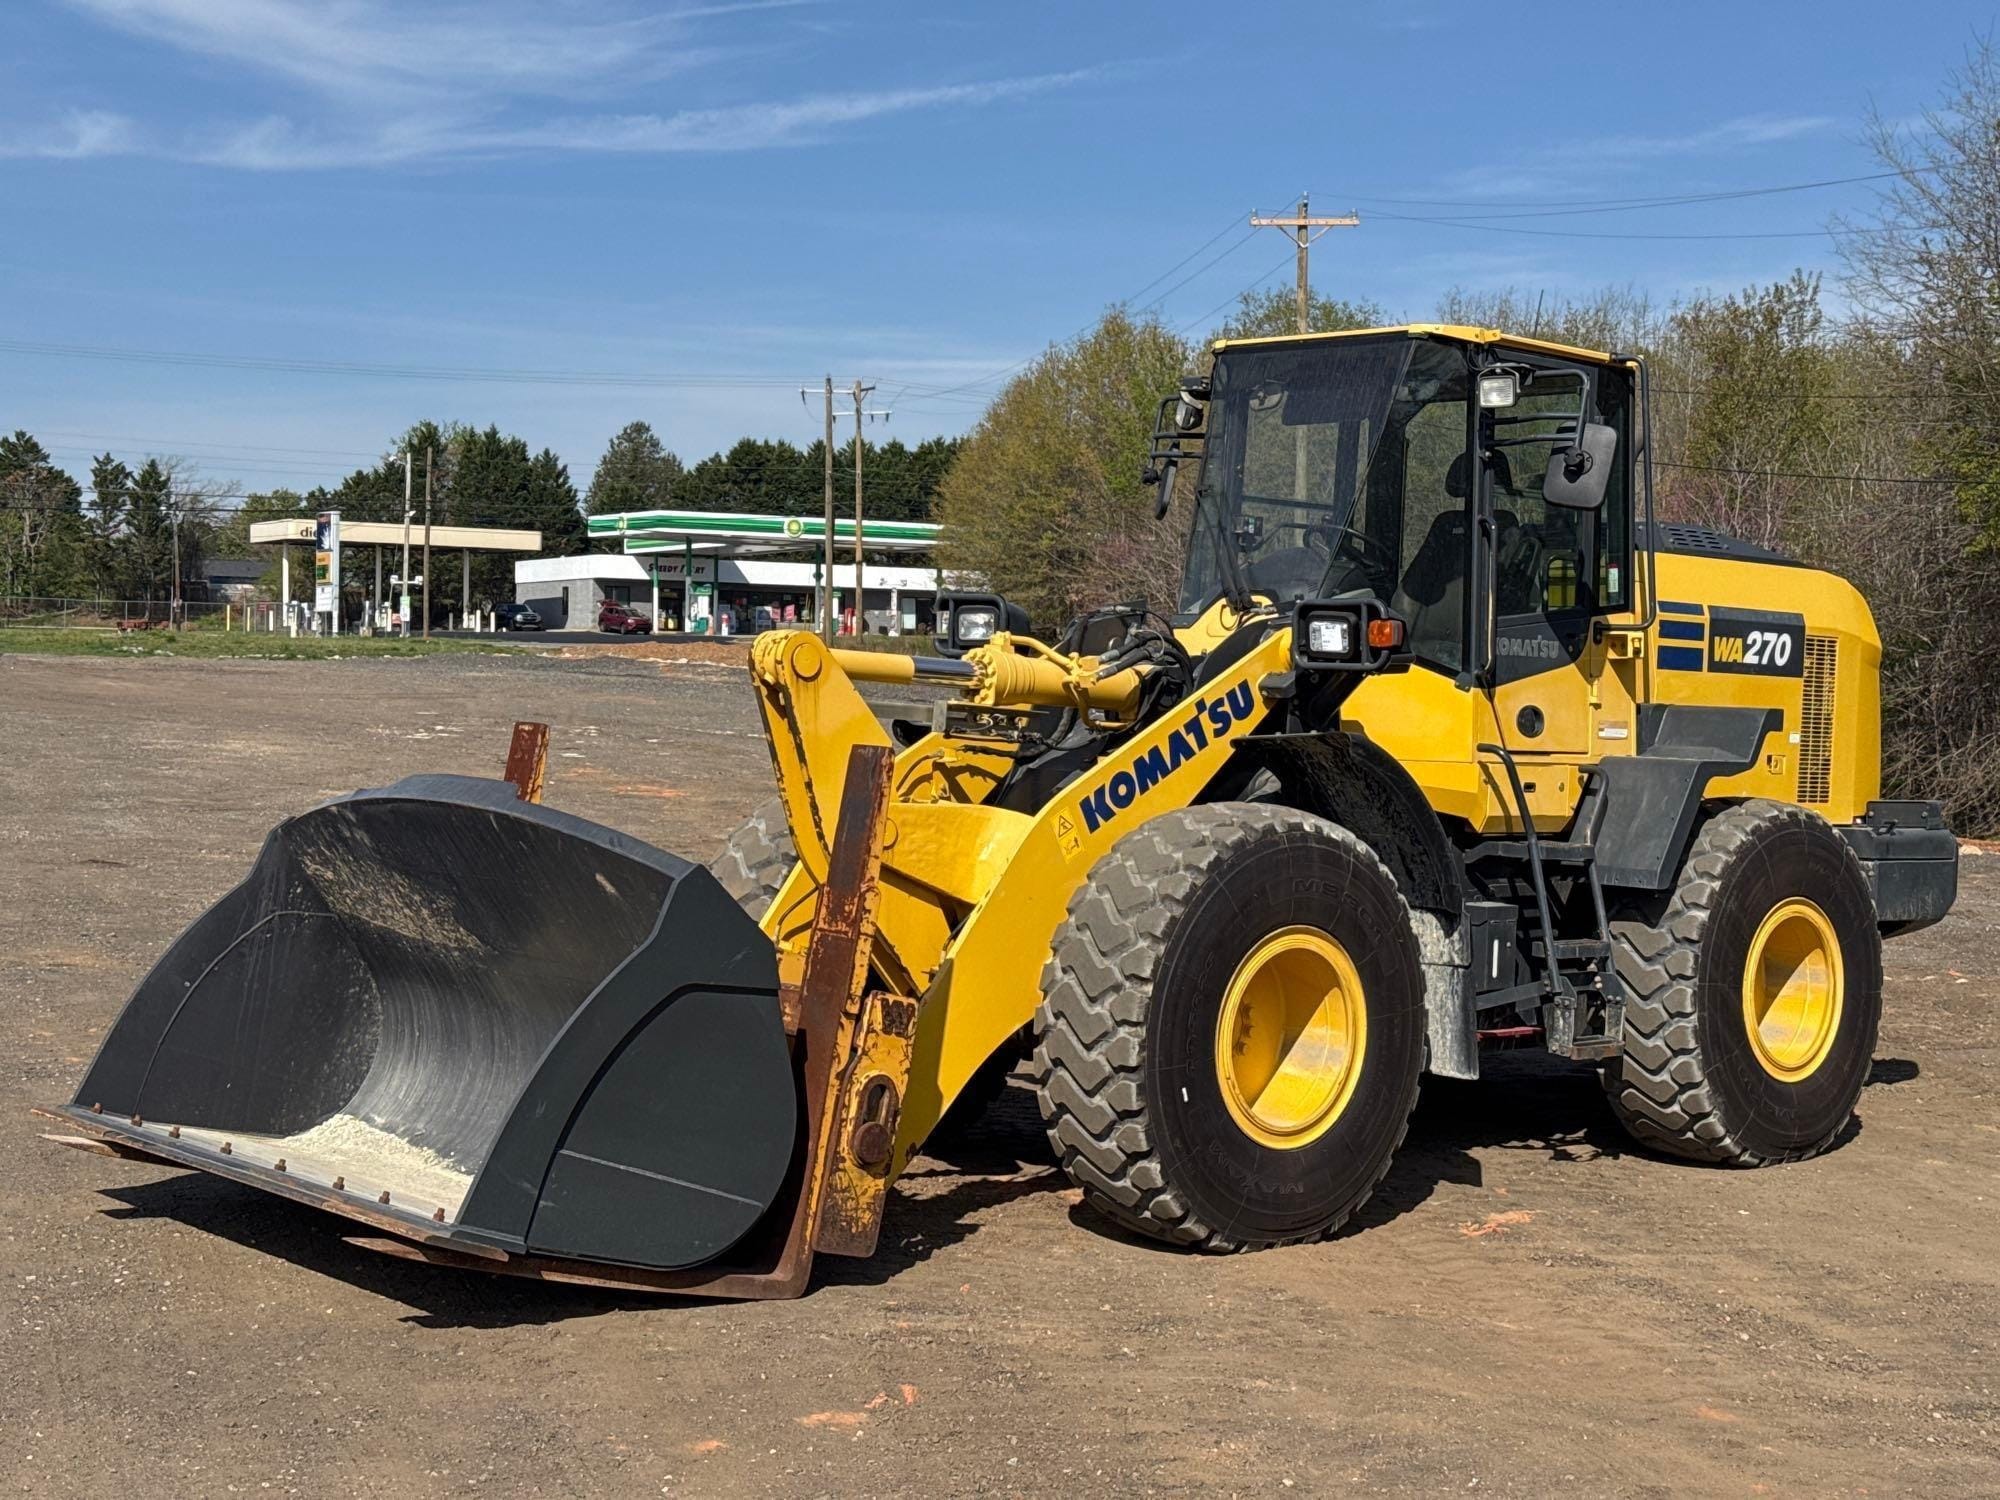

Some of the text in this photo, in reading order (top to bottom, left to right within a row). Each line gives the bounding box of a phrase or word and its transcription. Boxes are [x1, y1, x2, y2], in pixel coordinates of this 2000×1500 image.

[648, 562, 678, 573] SEEDY
[1714, 630, 1792, 667] WA270
[1079, 678, 1255, 834] KOMATSU
